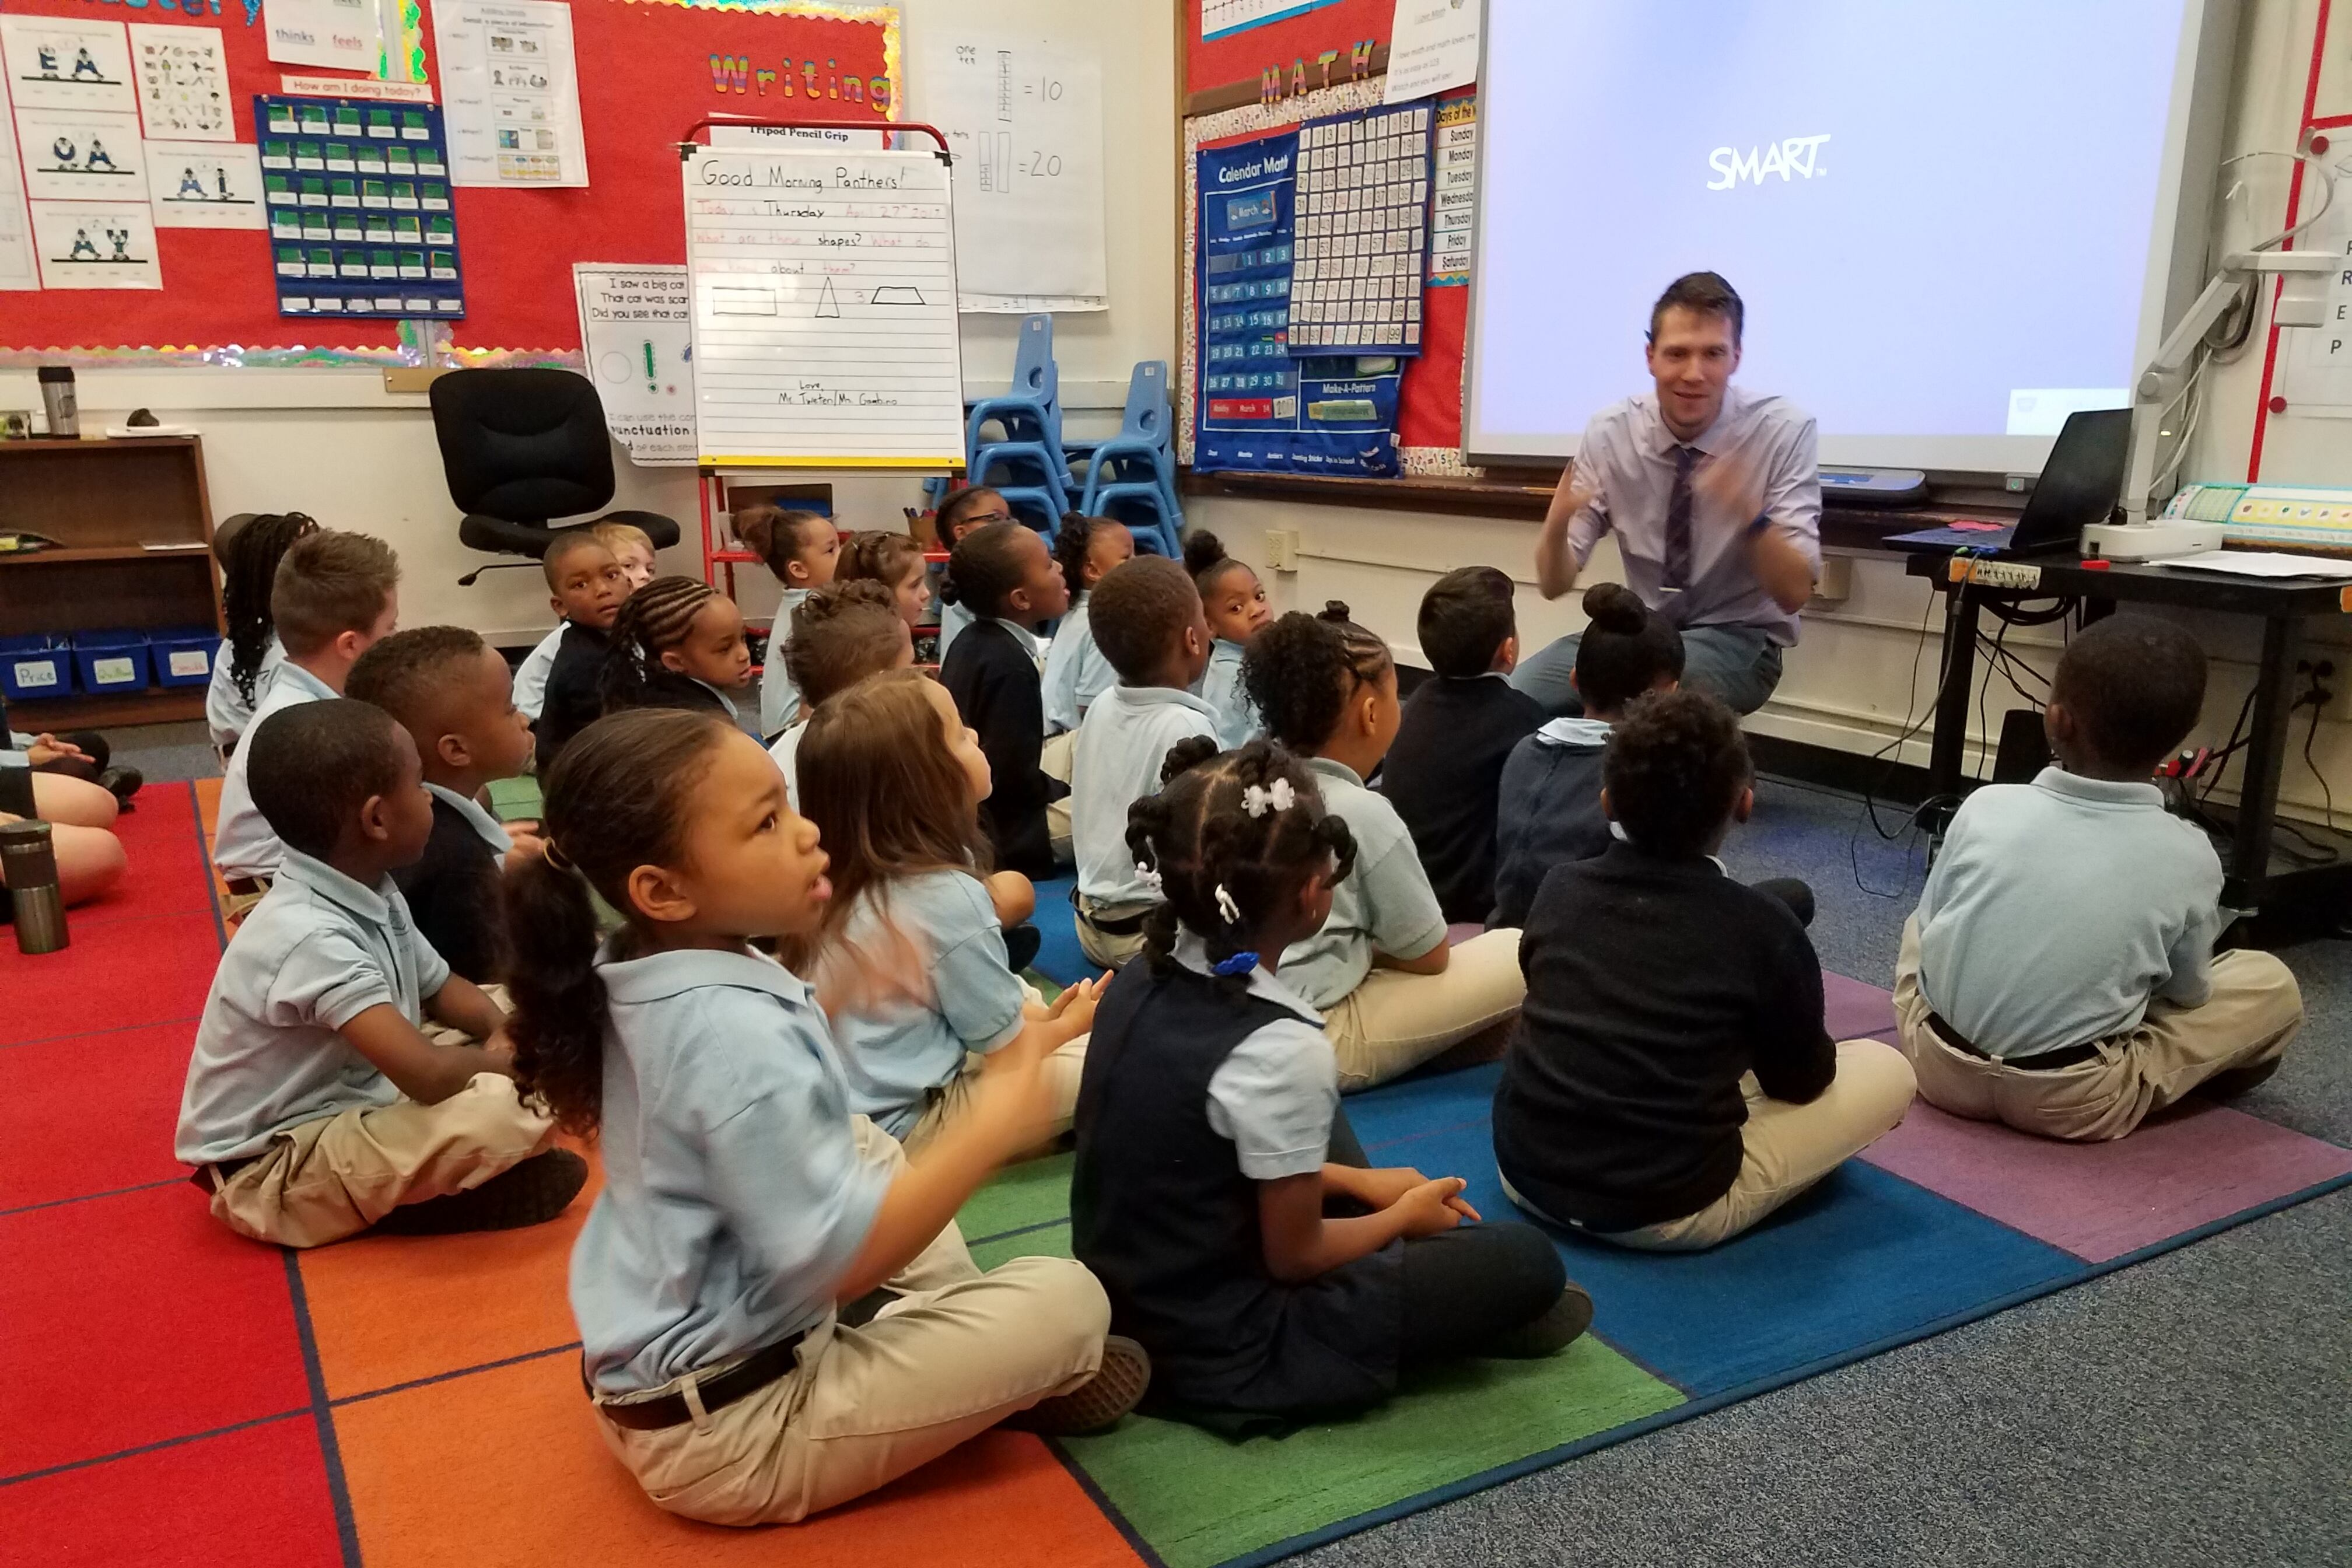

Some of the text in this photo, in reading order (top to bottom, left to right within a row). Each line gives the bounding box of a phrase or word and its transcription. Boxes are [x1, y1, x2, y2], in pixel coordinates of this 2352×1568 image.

[276, 29, 363, 48] thinks feels
[956, 46, 975, 54] one
[1261, 39, 1375, 104] MATH
[294, 81, 318, 90] How
[351, 84, 382, 96] doing
[385, 85, 421, 98] today?
[710, 54, 891, 113] Writing
[790, 128, 821, 139] Pencil
[825, 130, 848, 142] Grip
[1450, 128, 1474, 144] Sunday
[1448, 148, 1474, 164] Monday
[1706, 134, 1831, 190] SMART
[702, 159, 905, 194] Good Morning Panthers!
[1219, 154, 1289, 184] Calendar Math
[1447, 170, 1473, 186] Tuesday
[696, 199, 734, 217] Today
[764, 200, 824, 219] Thursday
[1444, 212, 1471, 228] Thursday
[818, 232, 862, 251] shapes?
[1447, 234, 1466, 249] Friday
[1248, 250, 1286, 265] 1 2 3
[1443, 256, 1468, 270] Saturday
[771, 260, 804, 274] about
[609, 278, 616, 289] I
[620, 279, 639, 289] saw
[642, 280, 649, 289] a
[652, 278, 667, 290] big
[1235, 287, 1240, 298] 7
[1250, 286, 1255, 296] 8
[1265, 284, 1272, 295] 9
[1279, 282, 1287, 293] 10
[601, 292, 624, 303] That
[627, 293, 642, 303] cat
[645, 296, 665, 304] was
[592, 307, 608, 318] Did
[612, 310, 630, 321] you
[633, 309, 649, 318] see
[652, 308, 670, 318] that
[2337, 304, 2347, 320] E
[1224, 317, 1231, 328] 13
[1236, 316, 1244, 327] 14
[1250, 314, 1259, 326] 15
[1263, 314, 1272, 326] 16
[1278, 314, 1286, 324] 17
[1212, 343, 1285, 359] 19 20 21 22 23 24
[2330, 340, 2343, 355] P
[799, 380, 824, 391] Love,
[1222, 377, 1230, 388] 27
[1250, 375, 1259, 386] 29
[1264, 376, 1272, 386] 30
[1322, 383, 1376, 394] Make-A-Pattern
[618, 414, 635, 422] can
[636, 414, 656, 422] use
[657, 412, 676, 422] the
[650, 442, 674, 453] each
